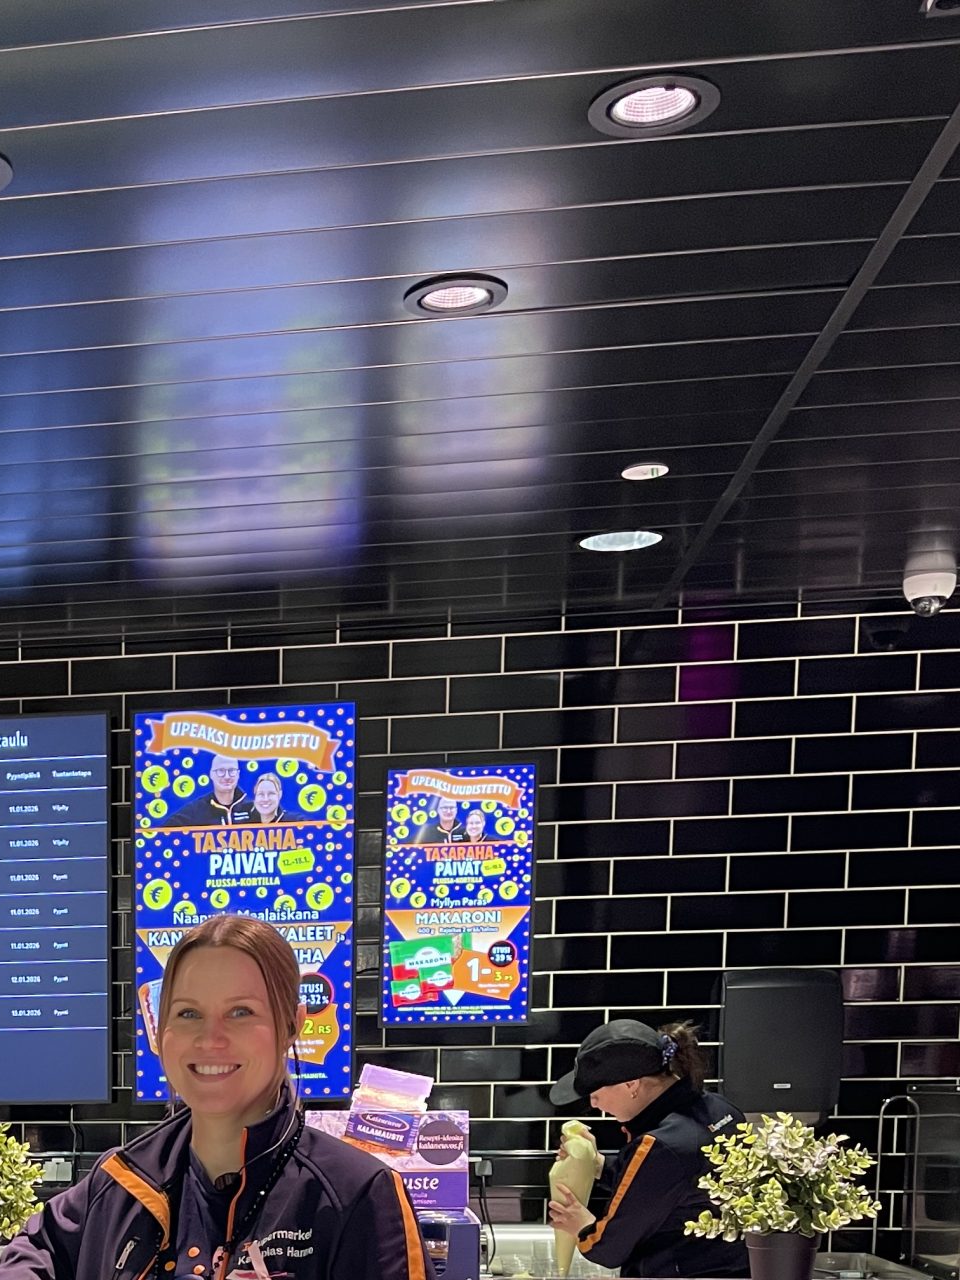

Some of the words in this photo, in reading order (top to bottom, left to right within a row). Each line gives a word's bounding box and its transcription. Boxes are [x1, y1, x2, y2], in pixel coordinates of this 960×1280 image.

[170, 722, 228, 746] UPEAKSI
[231, 733, 320, 750] UUDISTETTU
[411, 776, 451, 792] UPEAKSI
[452, 783, 512, 795] UUDISTETTU
[210, 848, 277, 875] PÄIVÄT
[435, 858, 481, 876] PÄIVÄT
[206, 877, 281, 888] PLUSSA-KORTILLA
[431, 897, 460, 908] Myllyn
[462, 897, 487, 906] Paras
[416, 910, 501, 924] MAKARONI
[303, 1020, 315, 1034] 2
[318, 1025, 332, 1034] RS
[356, 1124, 405, 1142] KALAMAUSTE
[419, 1140, 464, 1150] kalaneuvos.fi
